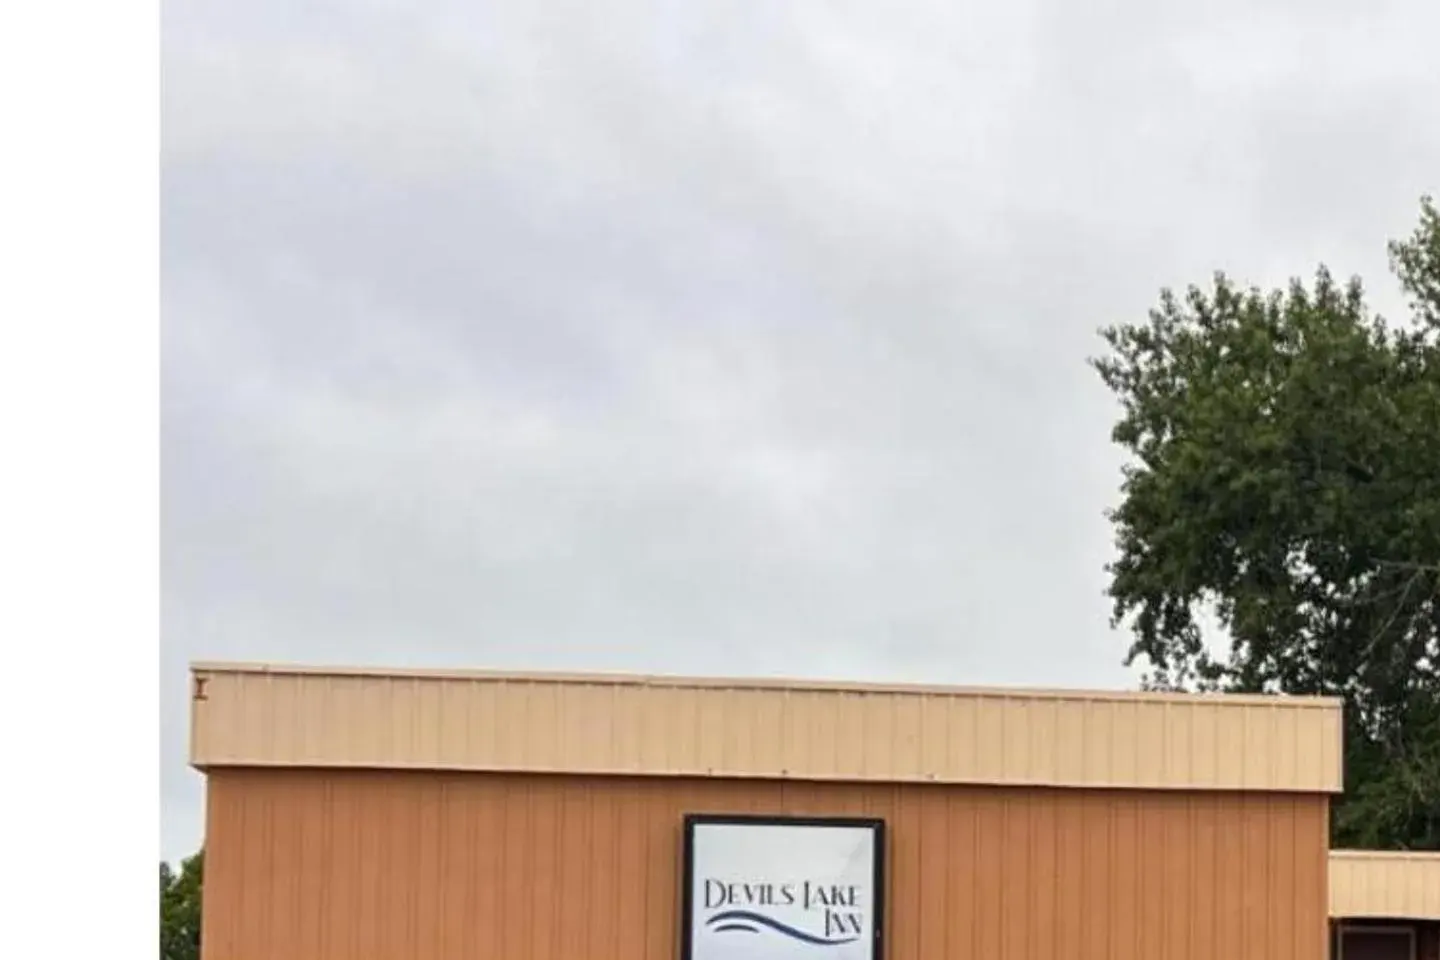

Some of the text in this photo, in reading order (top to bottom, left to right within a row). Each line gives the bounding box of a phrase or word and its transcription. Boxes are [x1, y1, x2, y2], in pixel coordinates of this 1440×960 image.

[704, 879, 861, 910] DEVILS LAKE
[825, 908, 862, 937] INN
